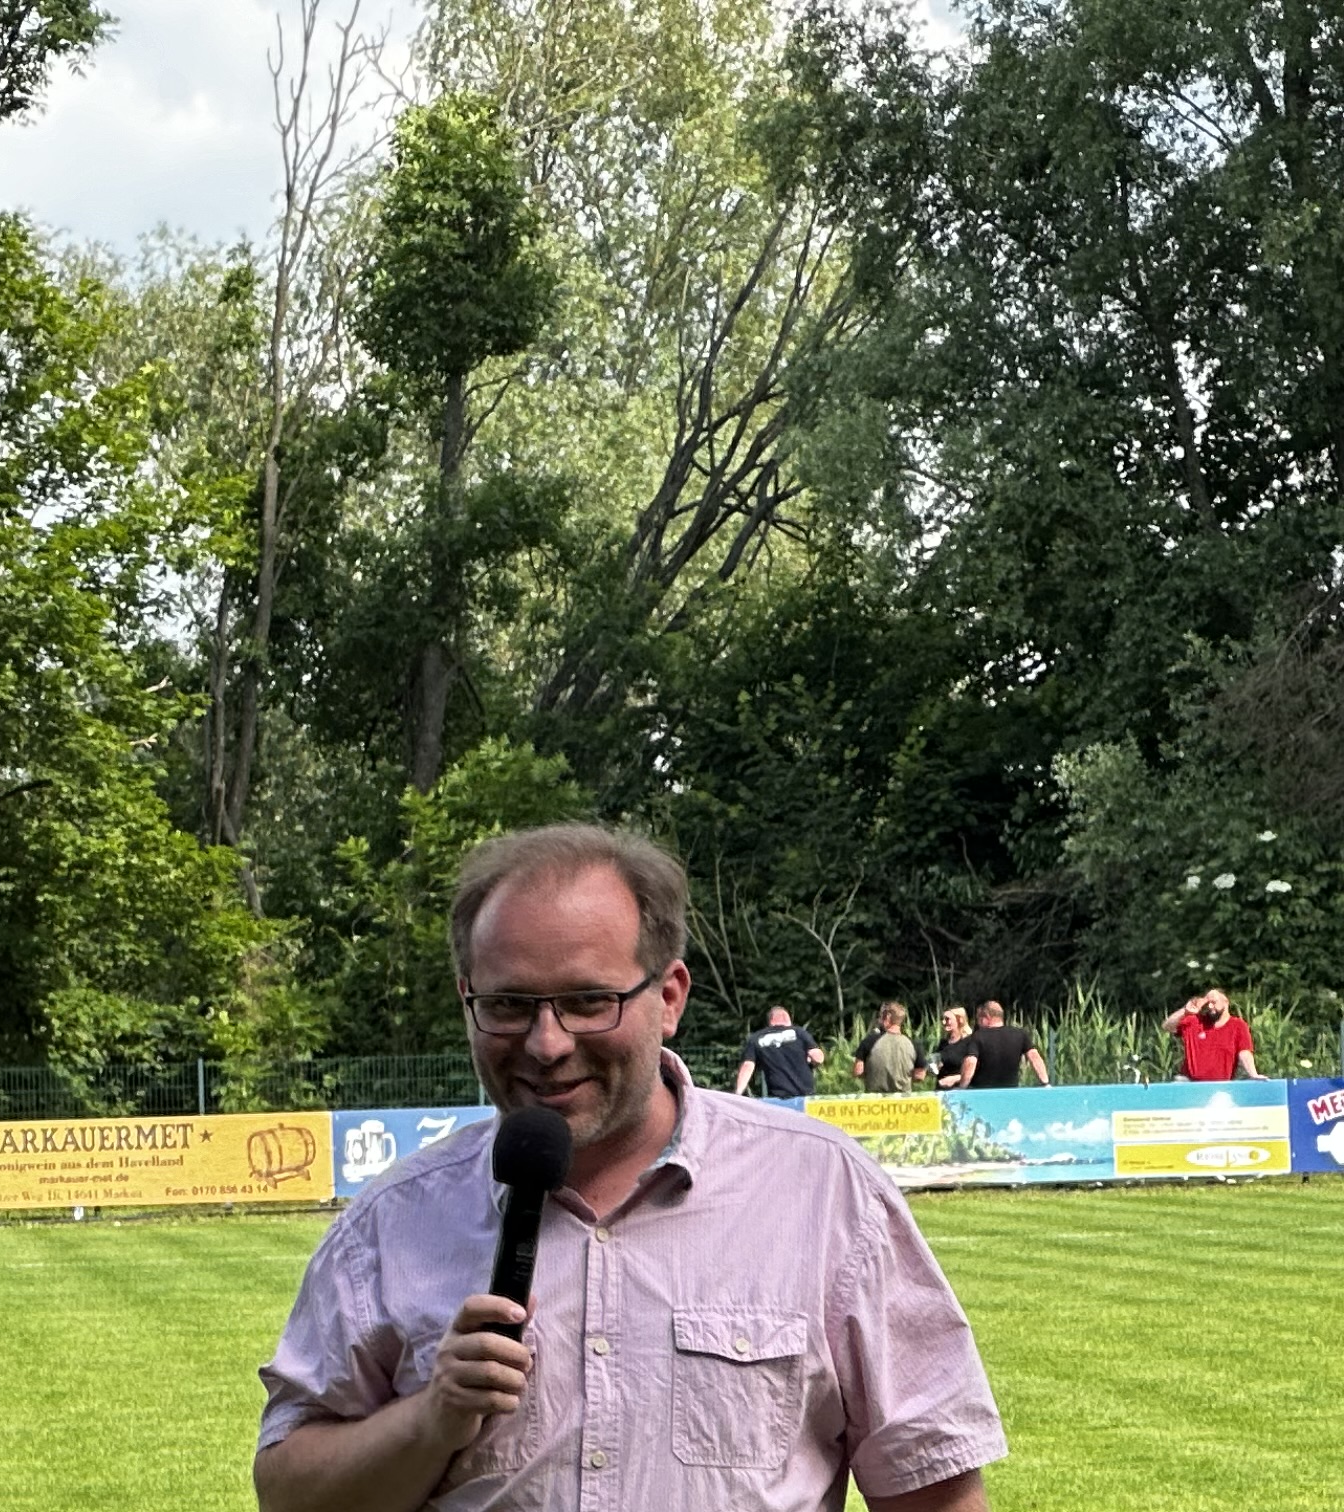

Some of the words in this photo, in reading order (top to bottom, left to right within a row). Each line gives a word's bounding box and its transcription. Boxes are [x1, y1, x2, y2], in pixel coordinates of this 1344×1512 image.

[857, 1102, 930, 1116] RICHTUNG
[61, 1162, 81, 1170] aus
[86, 1157, 113, 1169] dem
[119, 1155, 183, 1168] Havelland
[191, 1185, 217, 1195] 0170
